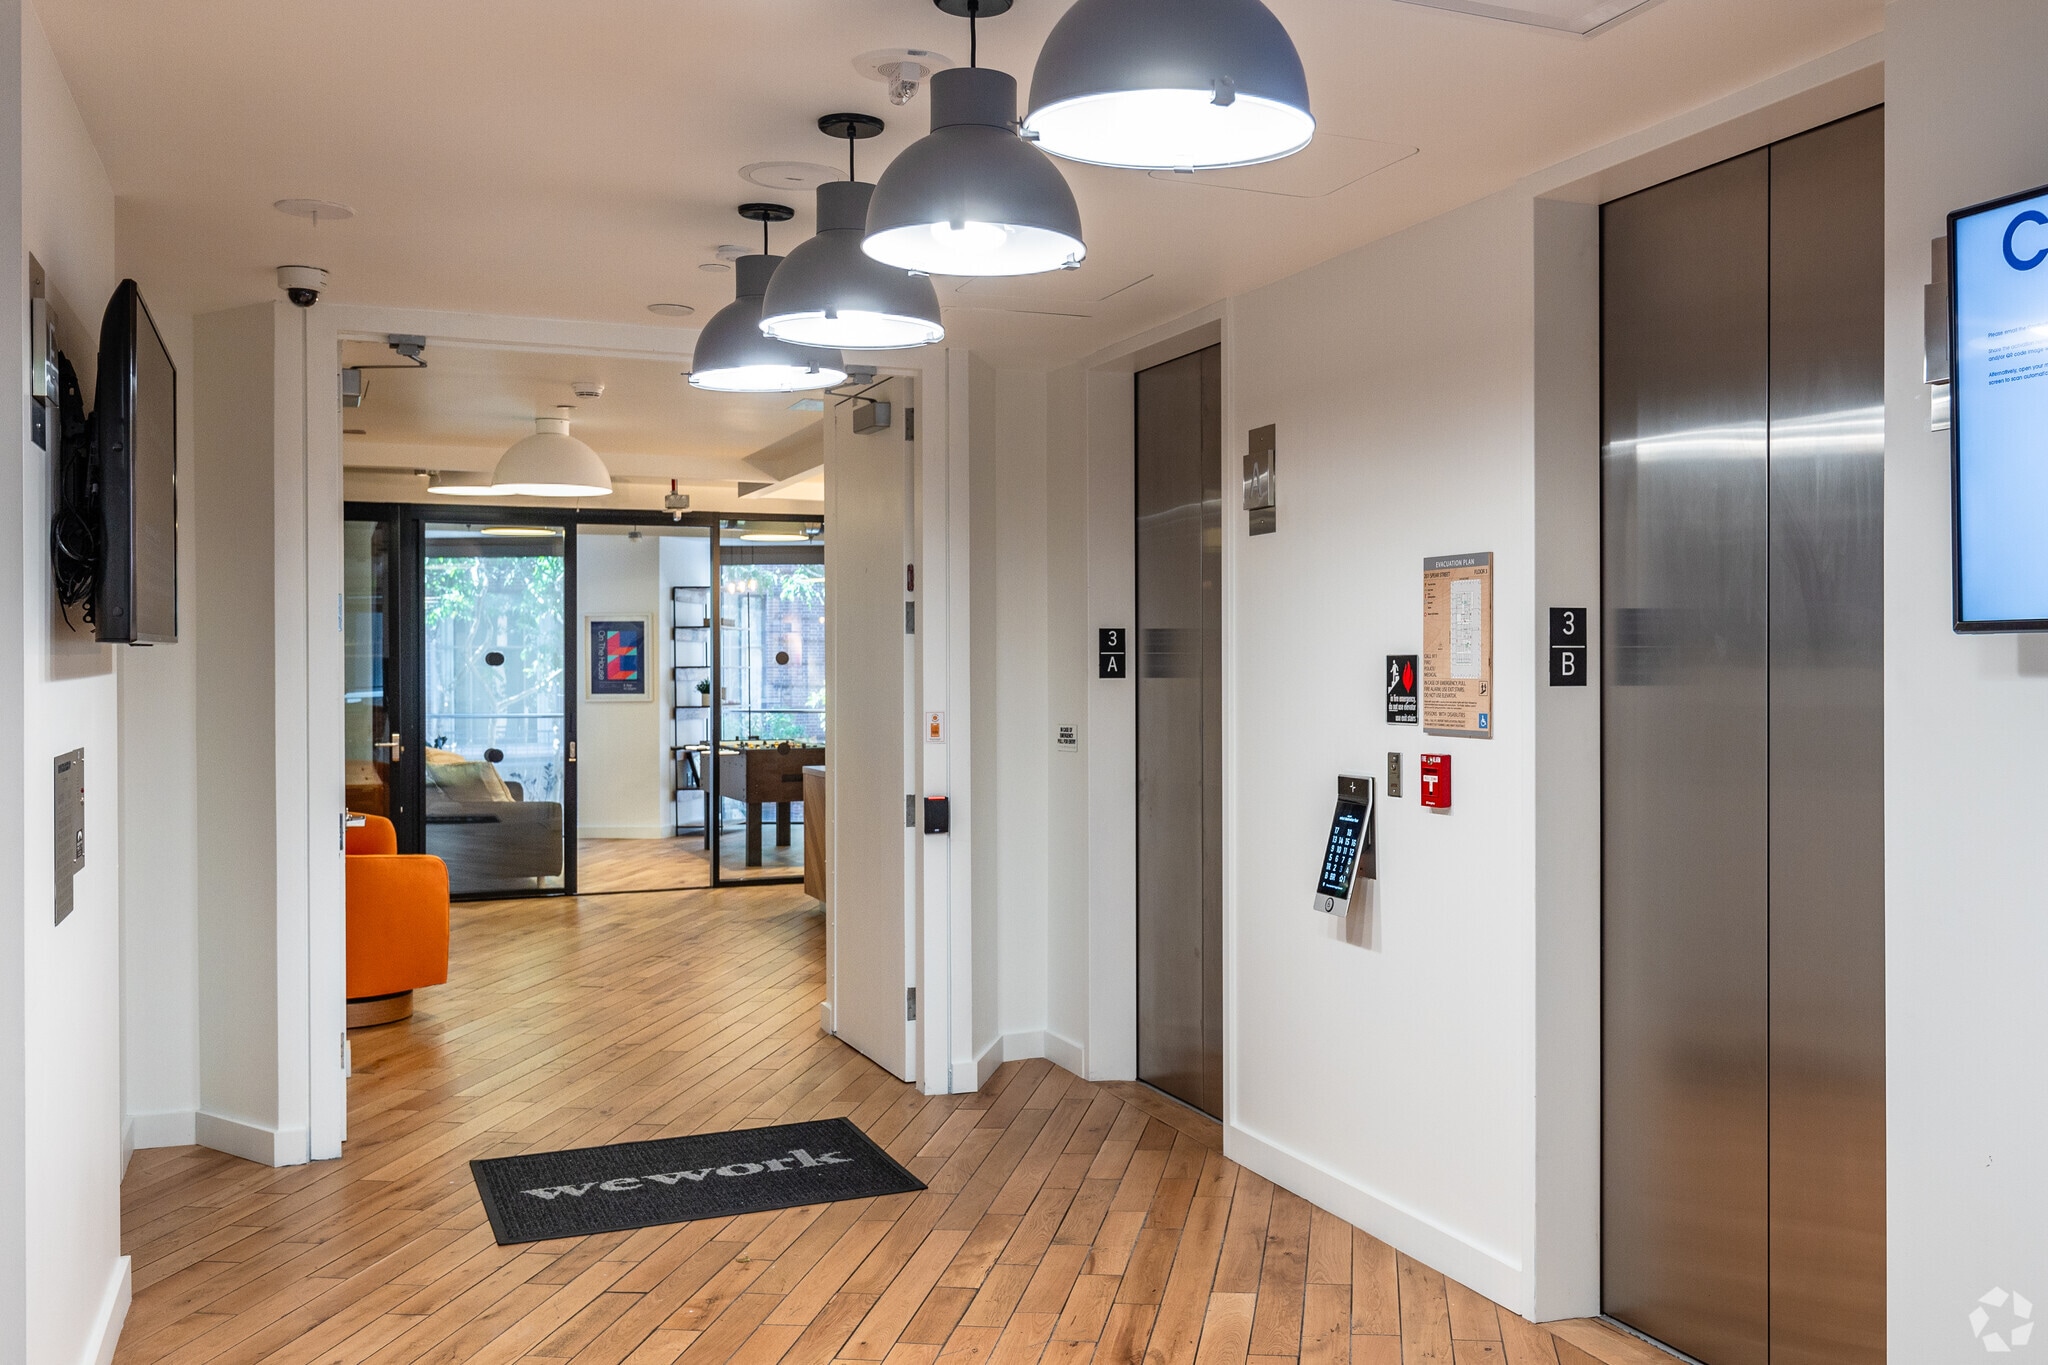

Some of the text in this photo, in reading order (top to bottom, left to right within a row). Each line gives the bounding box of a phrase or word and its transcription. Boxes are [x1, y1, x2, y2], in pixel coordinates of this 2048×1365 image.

[1988, 354, 2005, 362] and/or
[1435, 560, 1462, 568] EVACUATION
[1562, 611, 1575, 635] 3
[598, 630, 605, 641] On
[1108, 630, 1117, 646] 3
[598, 642, 606, 656] The
[1107, 656, 1118, 672] A
[1562, 651, 1575, 676] B
[1328, 853, 1333, 861] 5
[1335, 854, 1339, 863] 6
[1341, 856, 1345, 864] 7
[1349, 848, 1355, 856] 12
[520, 1148, 854, 1200] wework
